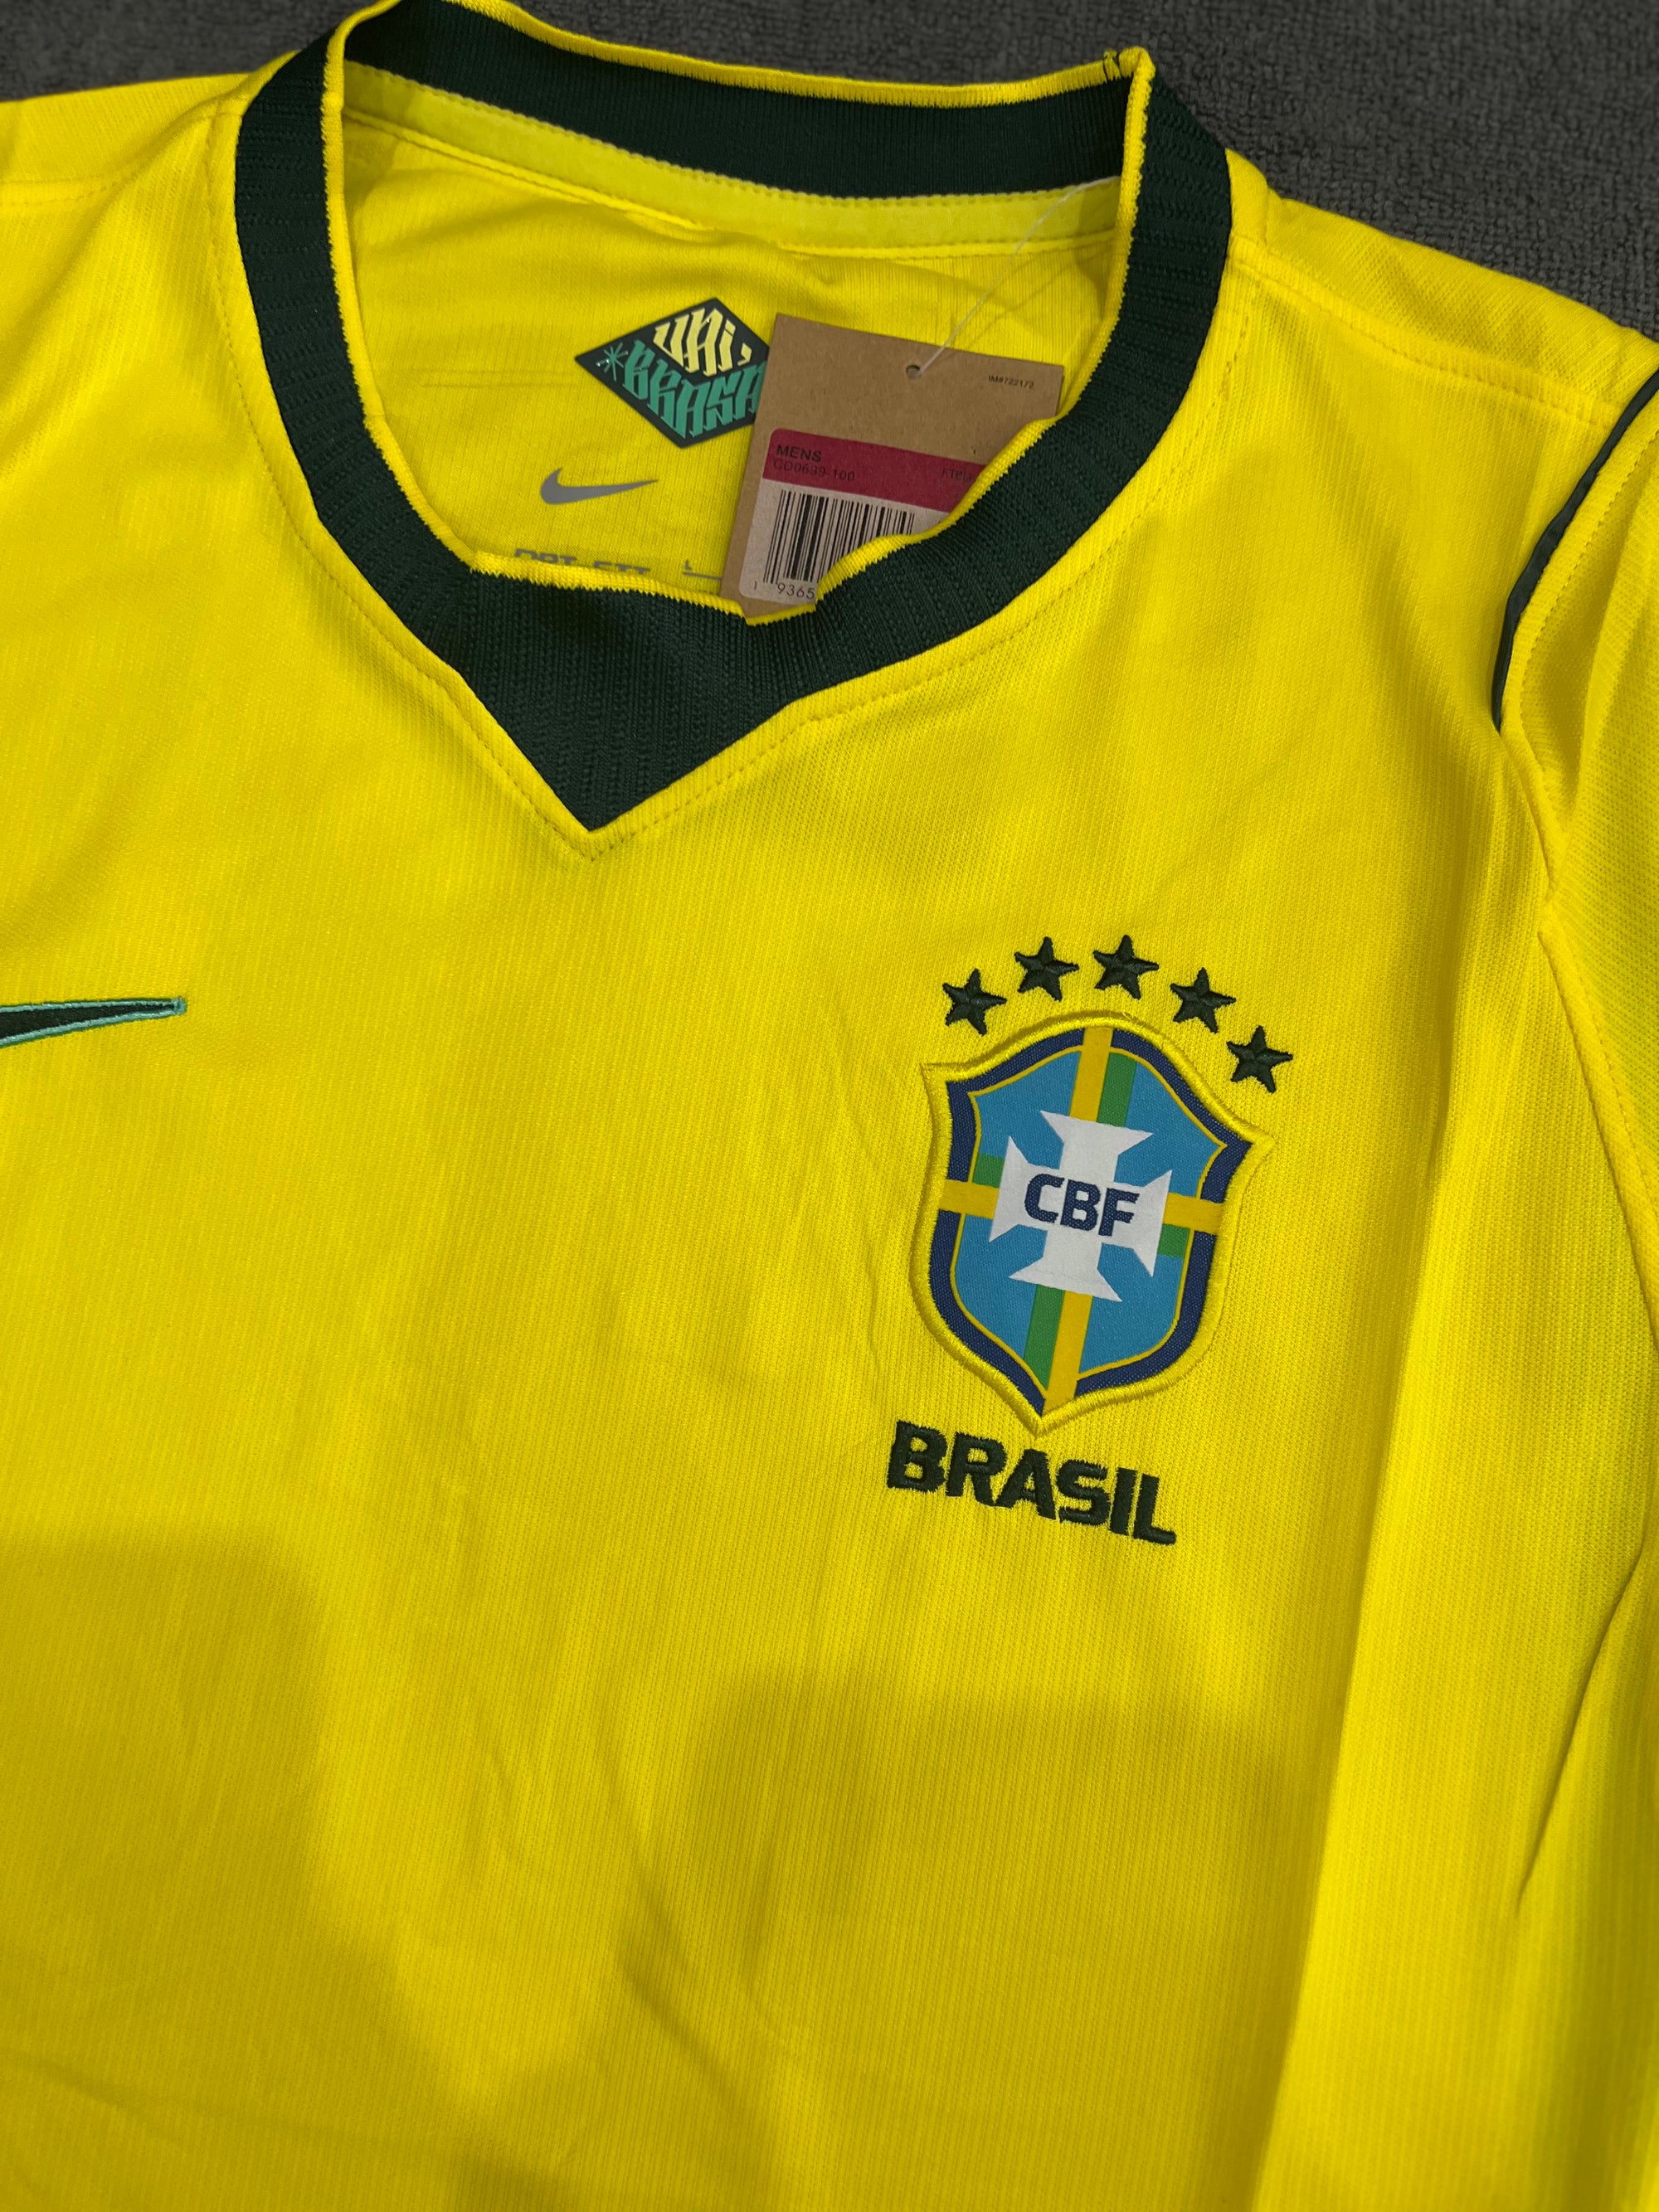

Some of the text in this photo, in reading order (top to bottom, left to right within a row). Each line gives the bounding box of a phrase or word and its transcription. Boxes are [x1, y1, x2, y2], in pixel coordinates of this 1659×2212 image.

[776, 444, 822, 463] MENS
[777, 582, 815, 600] 9365
[1024, 1173, 1141, 1237] CBF
[887, 1419, 1177, 1546] BRASIL
